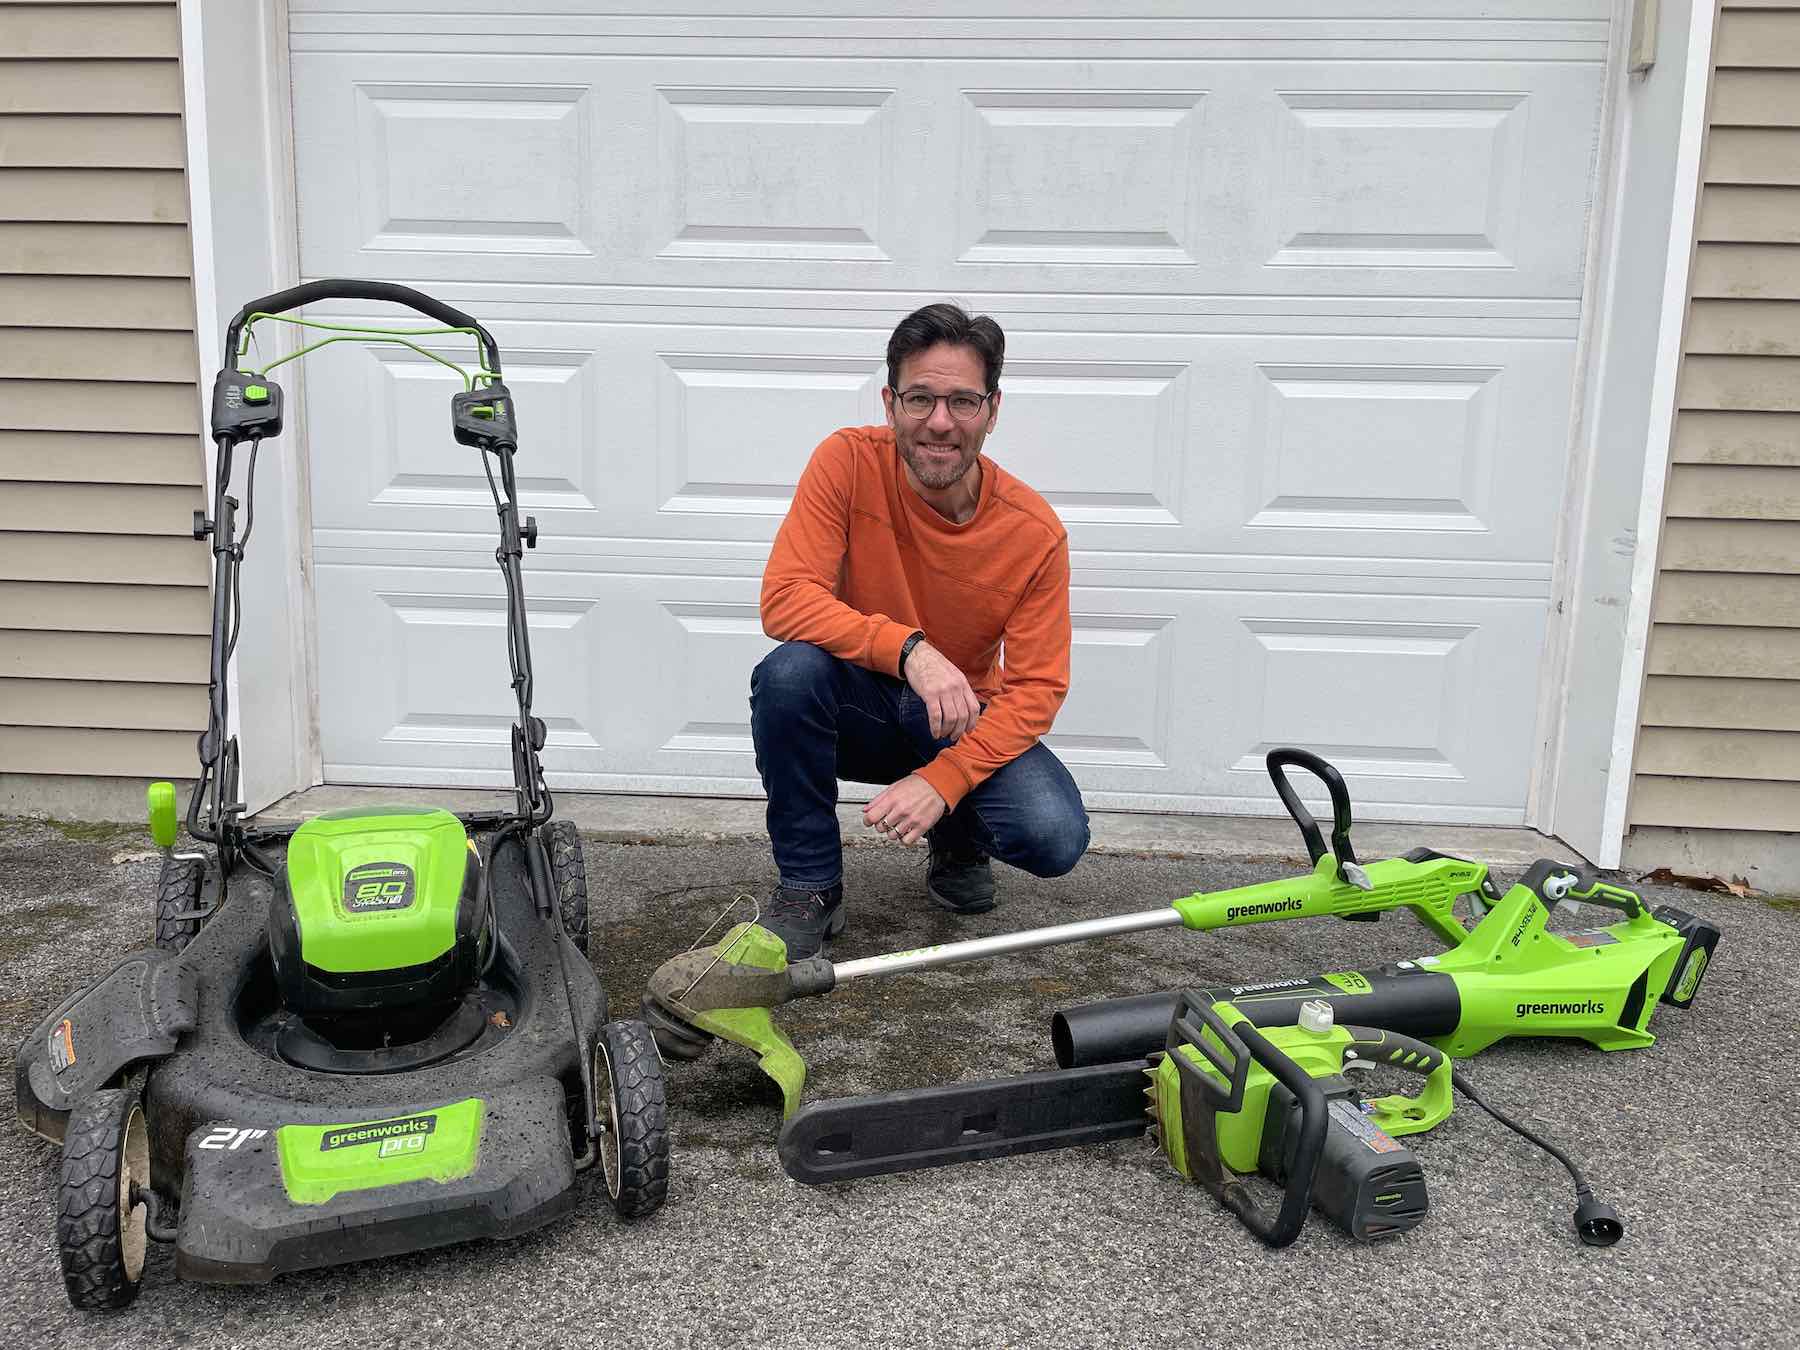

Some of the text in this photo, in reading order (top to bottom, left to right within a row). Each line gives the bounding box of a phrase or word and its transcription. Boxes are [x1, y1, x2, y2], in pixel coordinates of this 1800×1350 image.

[356, 882, 406, 899] 80
[1227, 897, 1303, 921] greenworks
[1230, 978, 1310, 995] greenworks
[1516, 1000, 1604, 1017] greenworks
[329, 1119, 429, 1147] greenworks
[382, 1134, 424, 1156] pro
